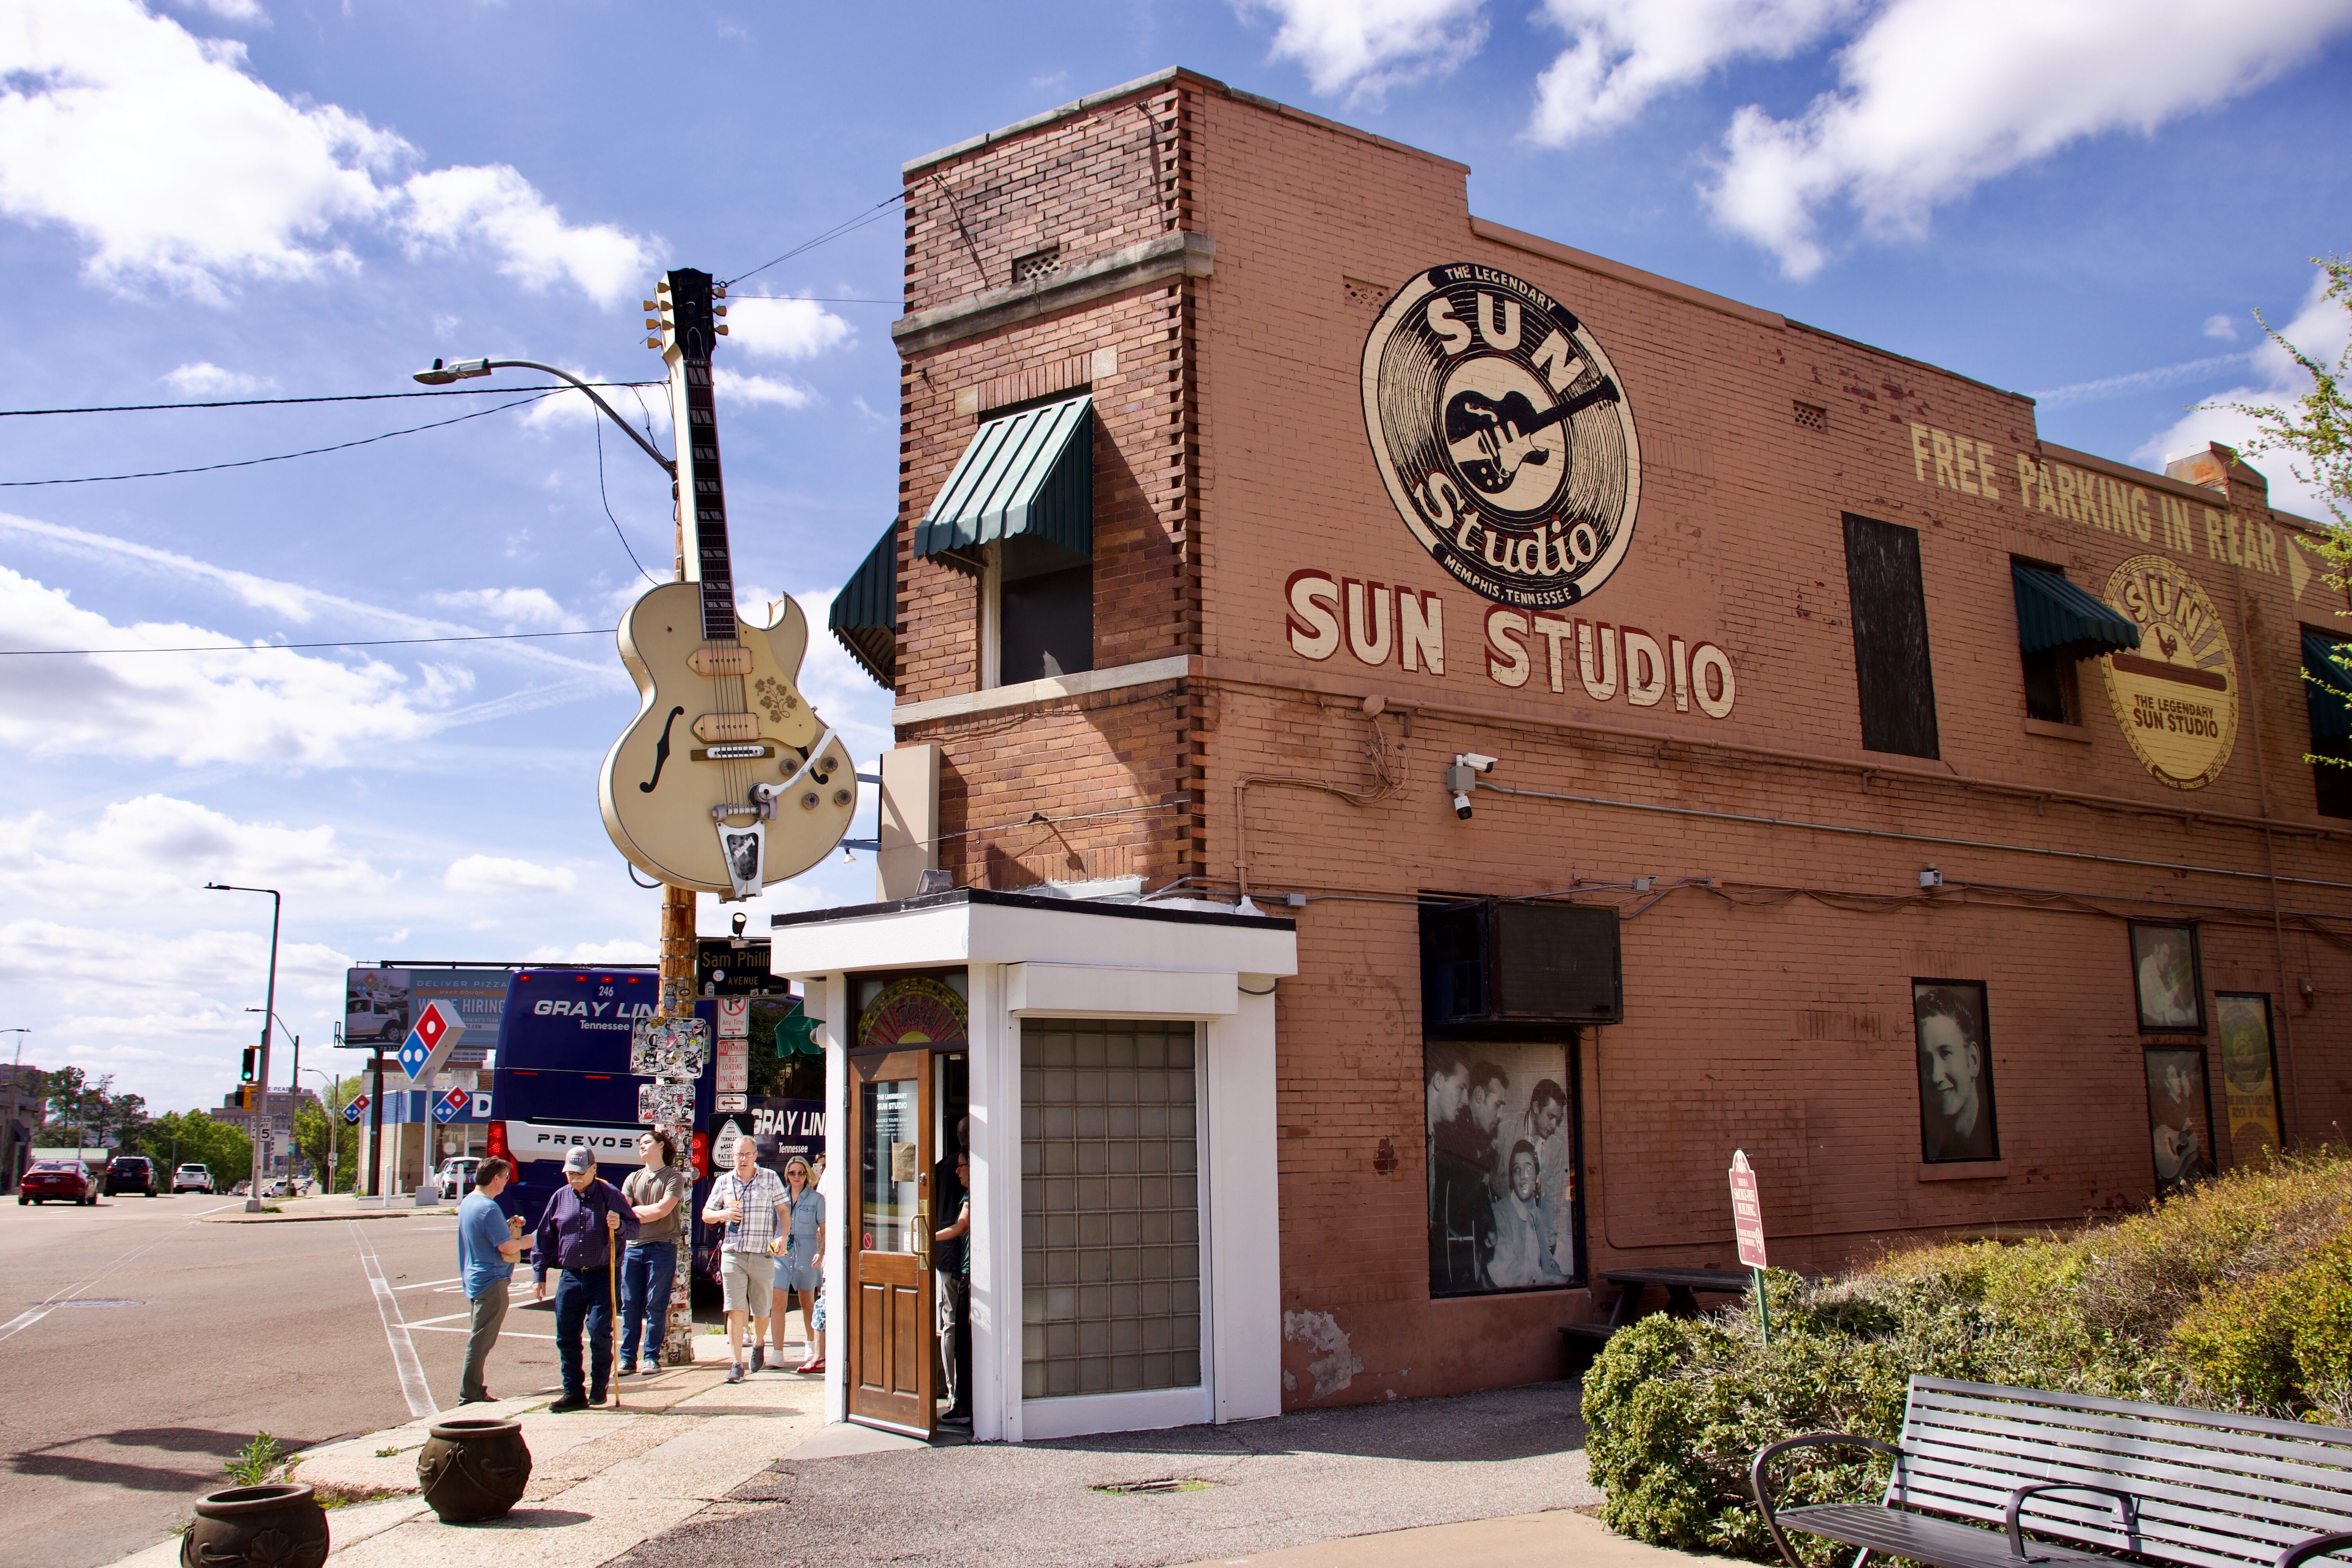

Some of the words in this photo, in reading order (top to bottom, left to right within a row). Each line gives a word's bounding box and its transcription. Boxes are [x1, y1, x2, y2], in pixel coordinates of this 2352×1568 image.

[1445, 265, 1471, 280] THE
[1475, 266, 1556, 311] LEGENDARY
[1426, 291, 1588, 393] SUN
[1910, 423, 2000, 500] FREE
[2017, 454, 2150, 543] PARKING
[2160, 495, 2193, 554] IN
[2204, 508, 2280, 576] REAR
[1412, 469, 1598, 576] Studio
[1444, 555, 1504, 601] MEMPHIS,
[1505, 587, 1572, 605] TENNESSEE
[2122, 573, 2202, 641] SUN
[1286, 569, 1445, 677] SUN
[1485, 604, 1737, 719] STUDIO
[2134, 694, 2154, 709] THE
[2158, 698, 2213, 719] LEGENDARY
[2133, 708, 2164, 730] SUN
[2167, 713, 2218, 738] STUDIO
[2155, 770, 2178, 788] MEMPHIS
[2180, 777, 2205, 789] TENNESSEE
[702, 951, 731, 967] Sam
[737, 951, 769, 967] Philli
[728, 976, 758, 985] AVENUE
[599, 986, 614, 996] 246
[462, 999, 505, 1014] HIRING
[534, 1000, 610, 1017] GRAY
[616, 1002, 659, 1018] LIN
[580, 1020, 630, 1031] Tennessee
[719, 1044, 728, 1053] NO
[877, 1102, 888, 1111] SUN
[888, 1102, 907, 1110] STUDIO
[751, 1108, 798, 1136] GRAY
[800, 1111, 826, 1136] LIN
[538, 1134, 640, 1148] PREVOS
[779, 1142, 808, 1153] Tennessee
[1733, 1188, 1756, 1202] SMOKE-FREE
